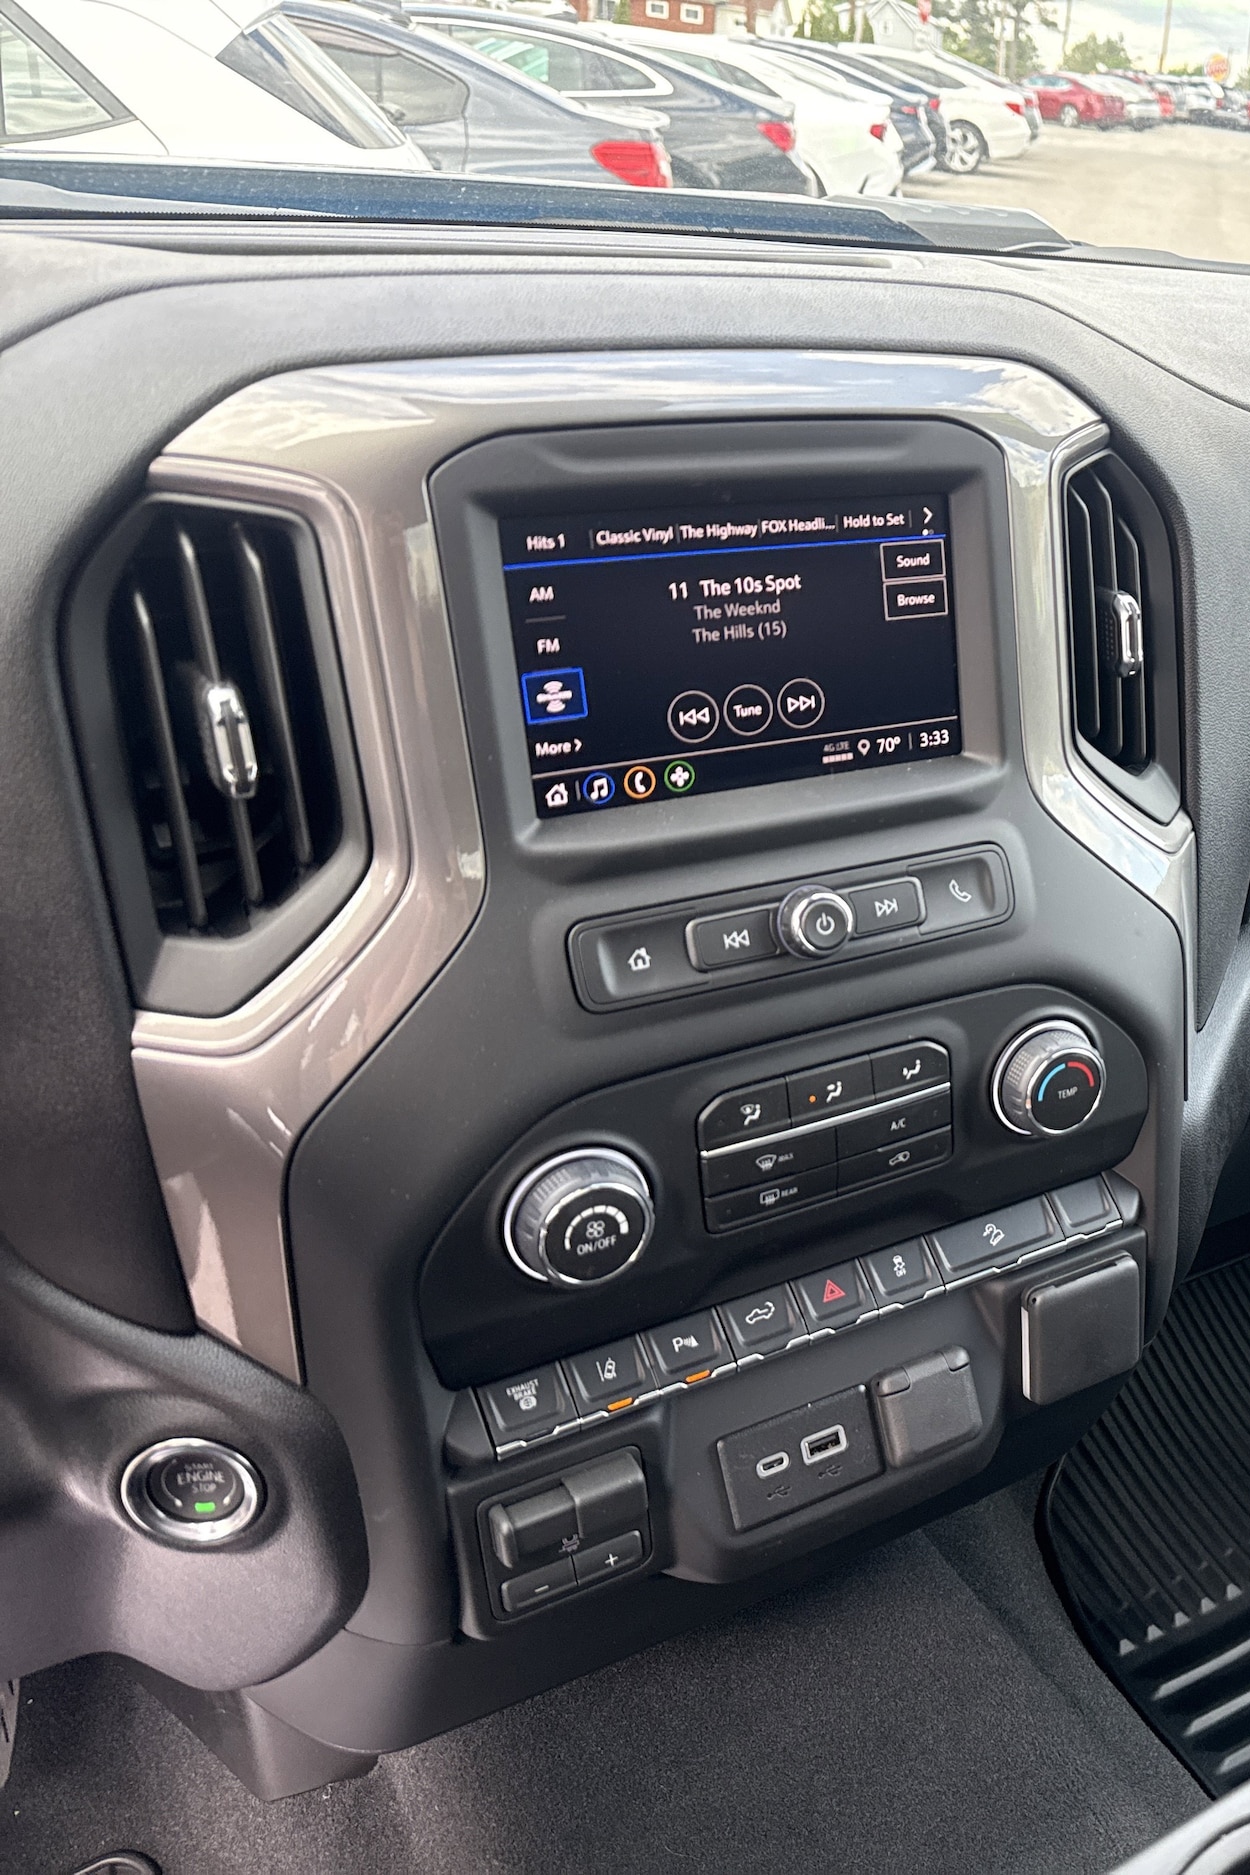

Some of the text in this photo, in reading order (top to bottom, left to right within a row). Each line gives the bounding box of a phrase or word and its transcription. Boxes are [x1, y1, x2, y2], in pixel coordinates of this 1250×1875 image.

[762, 517, 835, 534] FOX Headli...
[843, 513, 905, 529] Hold to Set
[596, 526, 674, 546] Classic Vinyl
[680, 522, 758, 541] The Highway
[526, 534, 566, 550] Hits 1
[896, 553, 930, 568] Sound
[529, 586, 554, 603] AM
[669, 574, 802, 600] 11 The 10s Spot
[897, 593, 935, 607] Browse
[693, 599, 781, 620] The Weeknd
[692, 620, 787, 643] The Hills (15)
[536, 638, 561, 655] FM
[733, 704, 762, 718] Tune
[919, 729, 950, 748] 3:33
[535, 742, 572, 758] More
[1058, 1086, 1078, 1100] TEMP
[891, 1118, 906, 1131] A/C
[781, 1187, 798, 1198] REAR
[577, 1234, 617, 1256] ON/OFF
[506, 1379, 539, 1397] EXHAUST
[513, 1386, 537, 1401] BRAKE
[177, 1470, 226, 1486] ENGINE
[192, 1483, 217, 1494] STOP
